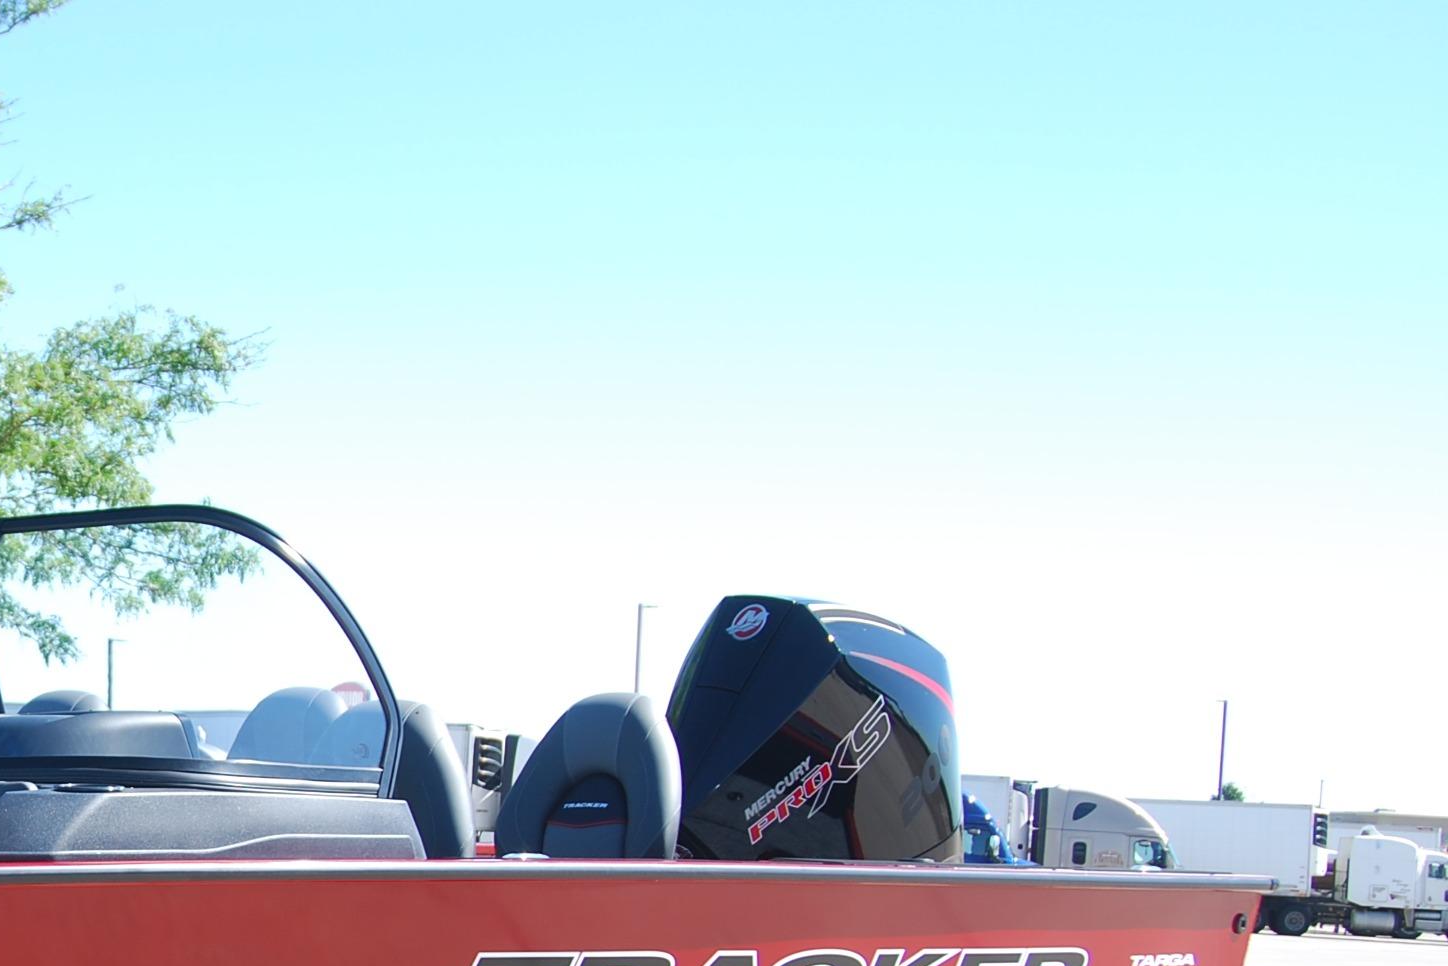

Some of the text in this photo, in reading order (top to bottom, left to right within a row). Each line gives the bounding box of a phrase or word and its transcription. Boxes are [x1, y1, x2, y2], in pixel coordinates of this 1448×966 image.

[744, 755, 812, 821] MERCURY
[748, 694, 891, 845] PRO XS
